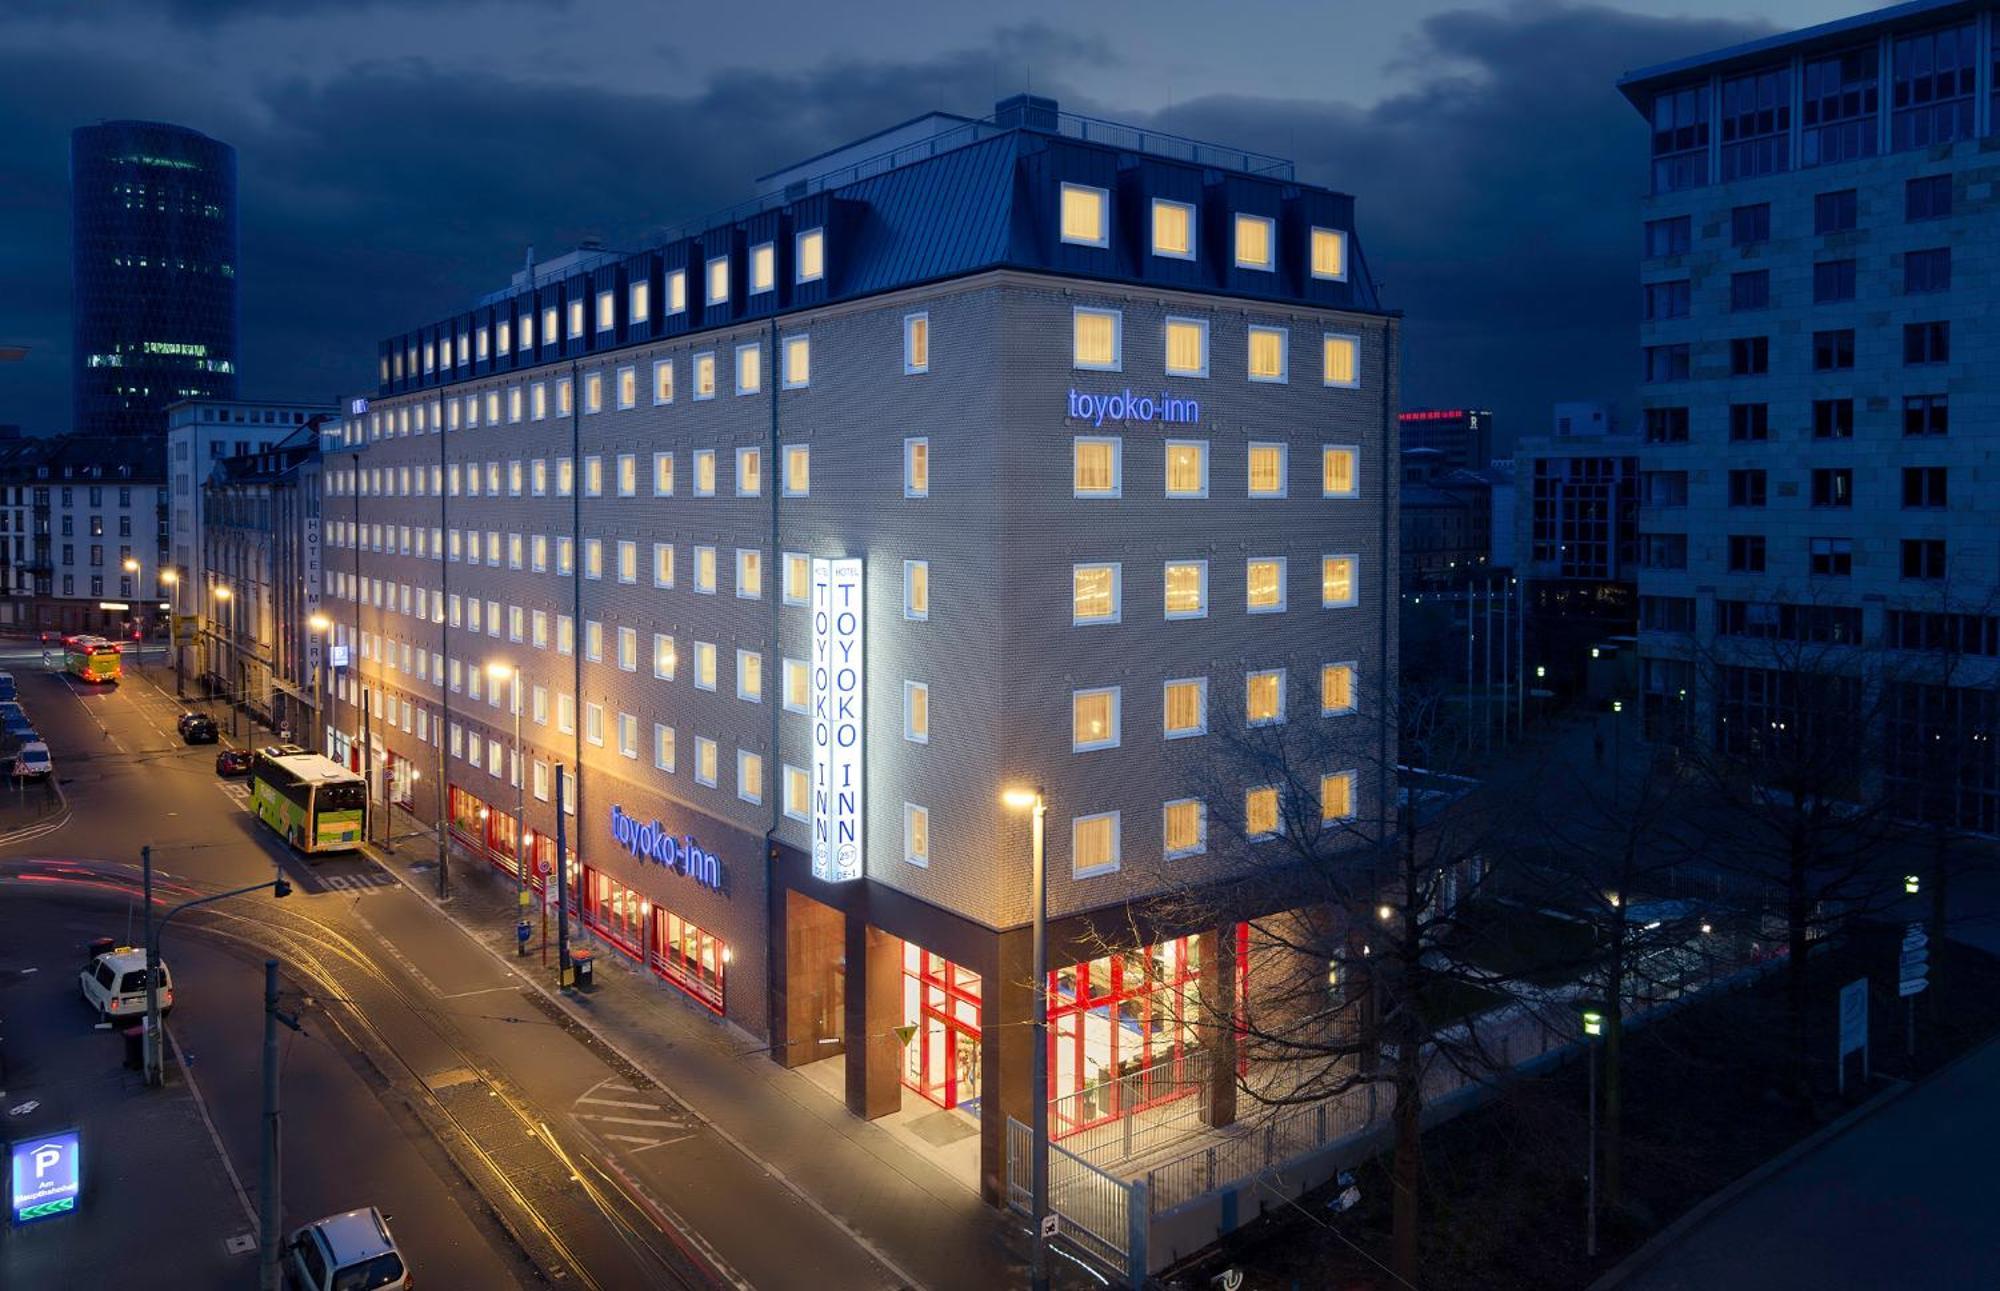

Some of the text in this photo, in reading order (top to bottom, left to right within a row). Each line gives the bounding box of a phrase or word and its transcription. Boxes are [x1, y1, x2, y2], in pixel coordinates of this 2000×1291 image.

[1069, 388, 1199, 427] toyoko-inn
[308, 520, 319, 684] HOTEL MIERV
[816, 583, 828, 746] TOYOKO
[837, 584, 857, 844] TOYOKO INN
[816, 762, 828, 842] INN
[611, 803, 721, 888] toyoko-inn
[35, 1150, 60, 1179] P
[39, 1181, 54, 1189] Am
